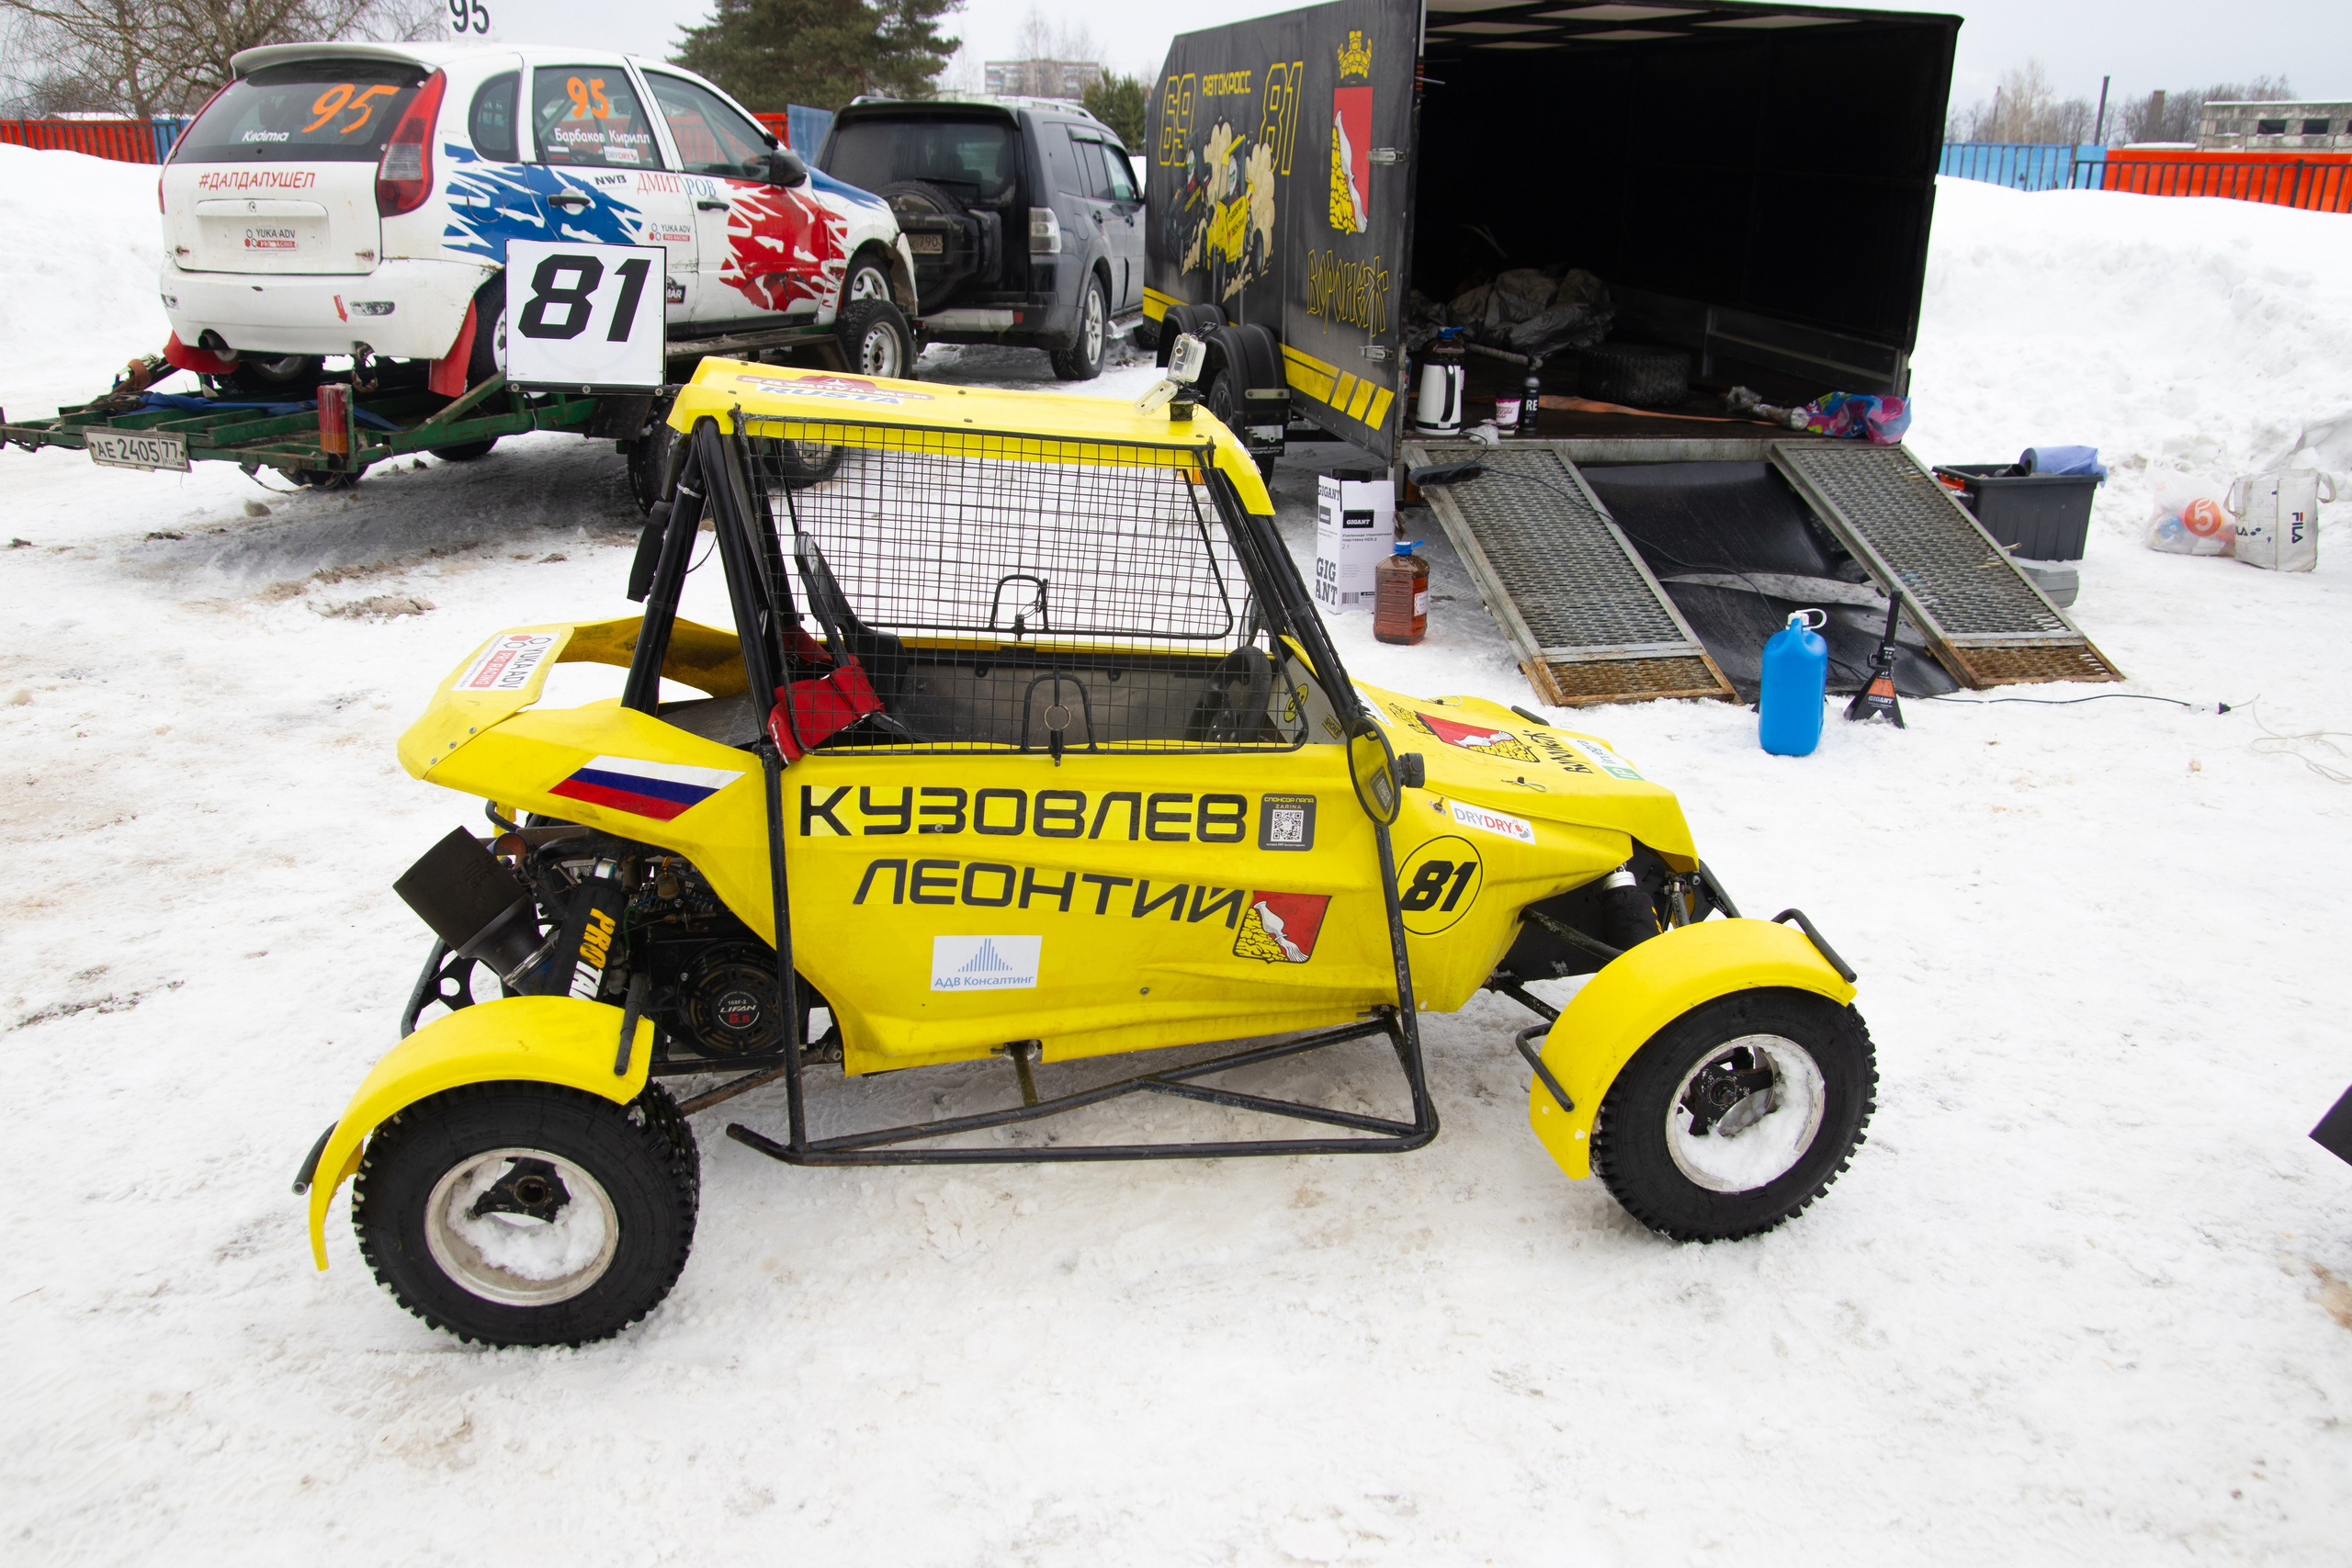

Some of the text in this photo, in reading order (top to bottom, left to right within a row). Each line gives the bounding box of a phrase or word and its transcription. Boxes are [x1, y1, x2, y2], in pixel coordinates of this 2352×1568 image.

[449, 0, 490, 34] 95
[1202, 70, 1251, 96] АВТОКРОСС
[300, 84, 401, 133] 95
[567, 76, 609, 119] 95
[1159, 73, 1196, 165] 69
[1259, 61, 1303, 175] 81
[554, 128, 650, 147] Барбаков Кирилл
[594, 175, 628, 186] NWB
[255, 229, 296, 239] YUKA ADV
[661, 223, 691, 233] YUKA ADV
[920, 236, 938, 247] 790
[518, 254, 651, 343] 81
[1307, 249, 1389, 337] ВОРОНЕЖ
[756, 385, 901, 405] RUSTA
[117, 438, 160, 463] 2405
[161, 441, 178, 458] 77
[1318, 484, 1340, 502] GIGANT
[2291, 512, 2303, 544] FILA
[1316, 557, 1337, 583] GIG
[1315, 579, 1338, 606] ANT
[474, 662, 503, 686] RACING
[498, 647, 547, 688] YUKA ADV
[1869, 695, 1894, 705] GIGANT
[800, 785, 1248, 843] КУЗОВЛЕВ
[1453, 807, 1512, 834] DRYDRY
[853, 859, 1246, 930] ЛЕОНТИЙ
[1400, 860, 1478, 912] 81
[568, 908, 616, 1001] PROTA
[934, 976, 1034, 988] АДВ Консалтинг
[720, 1005, 756, 1013] LIFAN
[729, 1013, 750, 1024] 6.5
